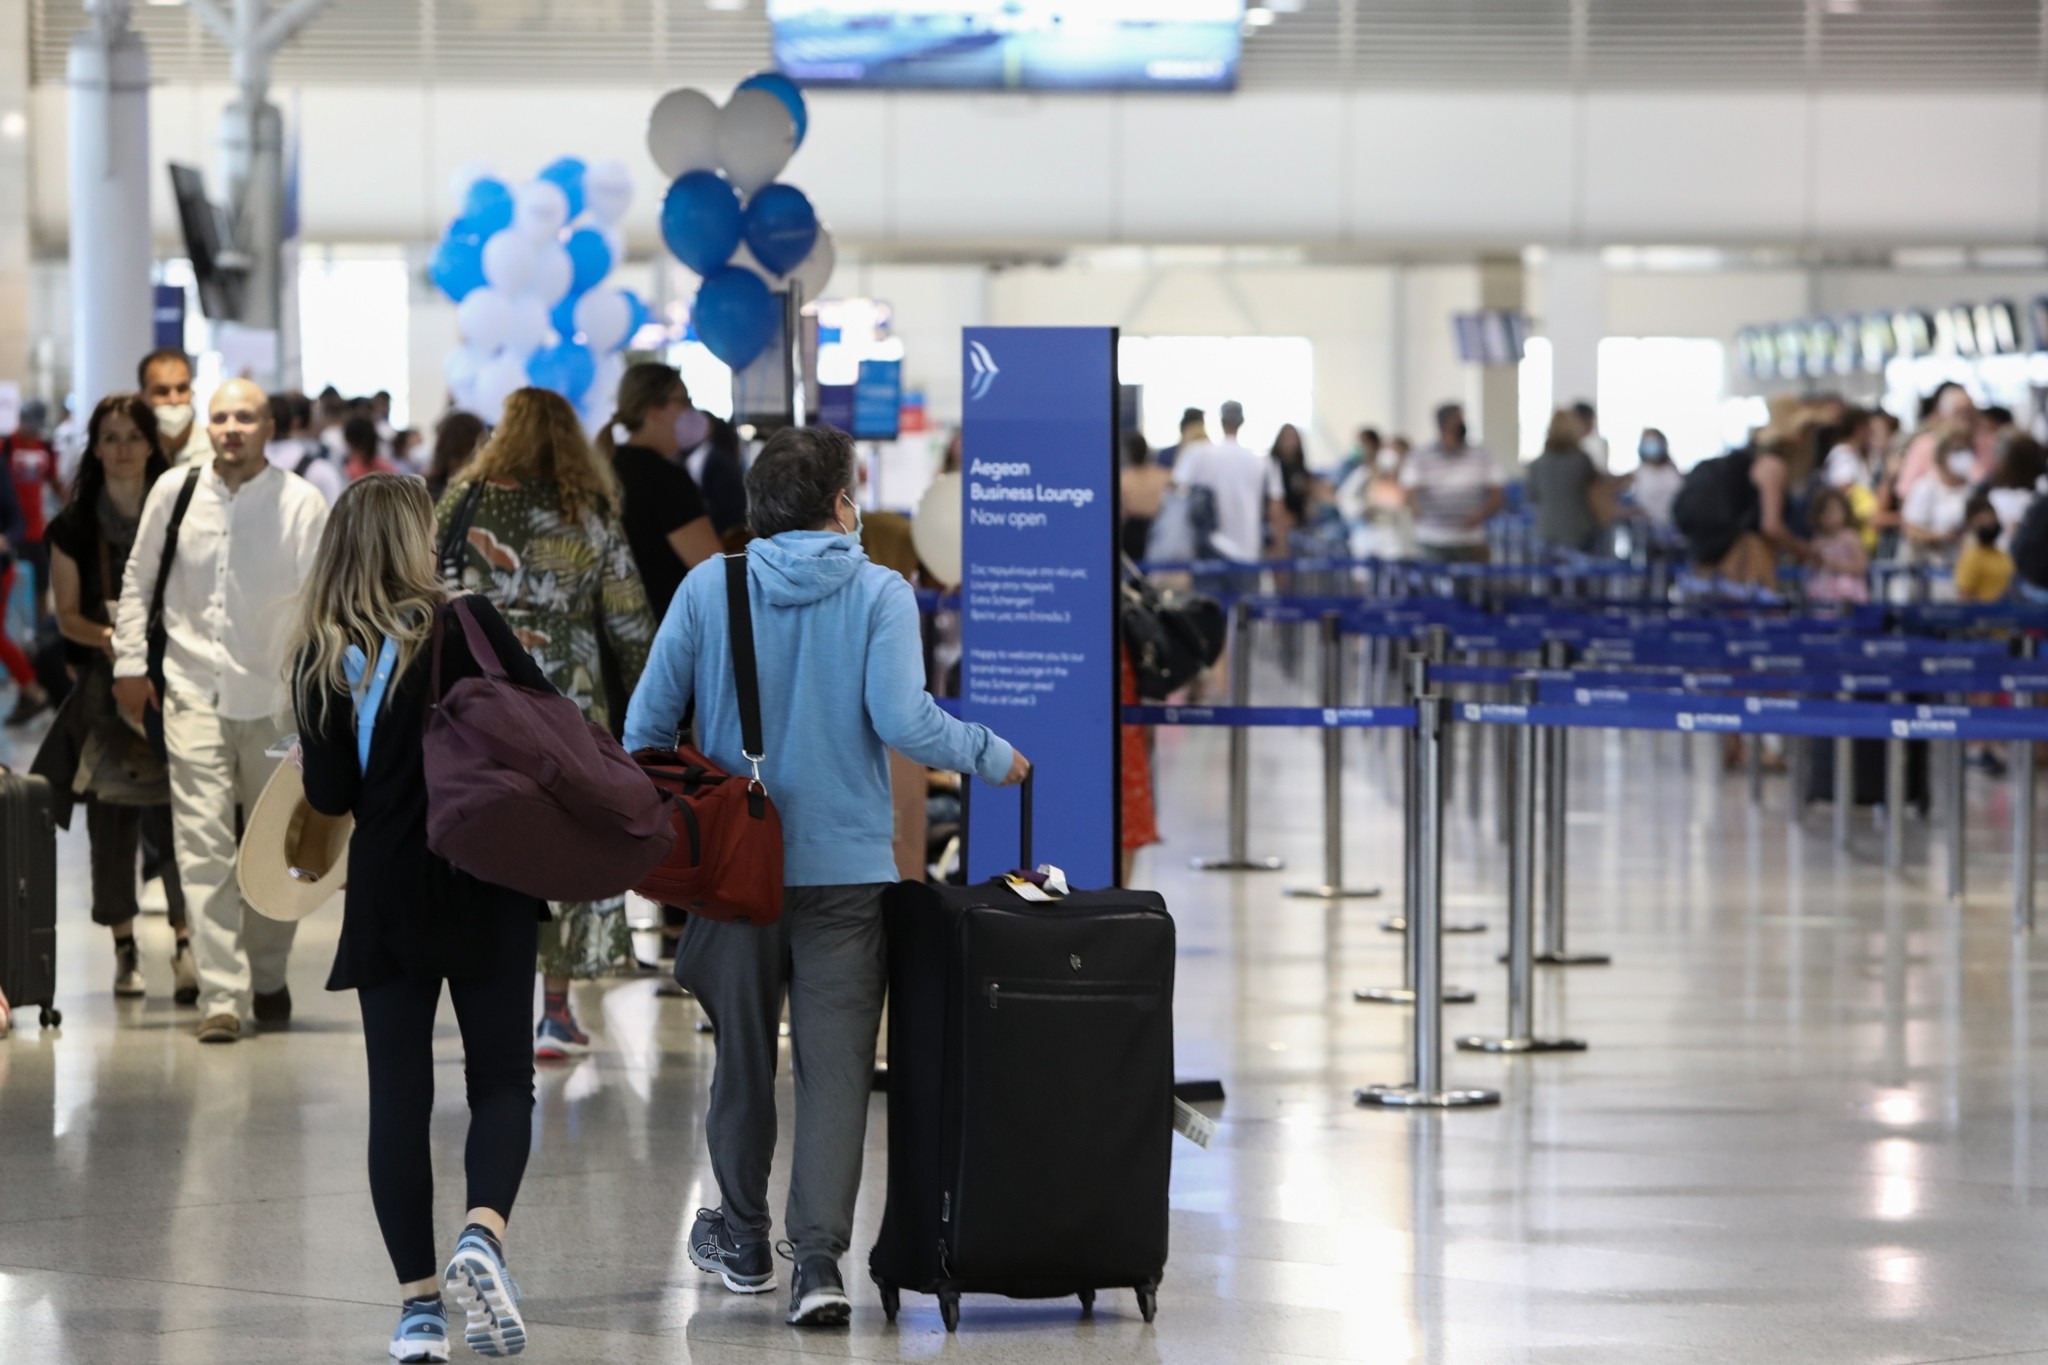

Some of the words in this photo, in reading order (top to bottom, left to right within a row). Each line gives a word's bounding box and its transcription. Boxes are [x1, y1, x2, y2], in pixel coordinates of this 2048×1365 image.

[970, 458, 1031, 481] Aegean
[970, 482, 1035, 501] Business
[1036, 483, 1094, 508] Lounge
[970, 509, 1006, 526] Now
[1008, 512, 1047, 530] open
[1695, 713, 1741, 725] ATHENS
[1909, 719, 1956, 731] ATHENS
